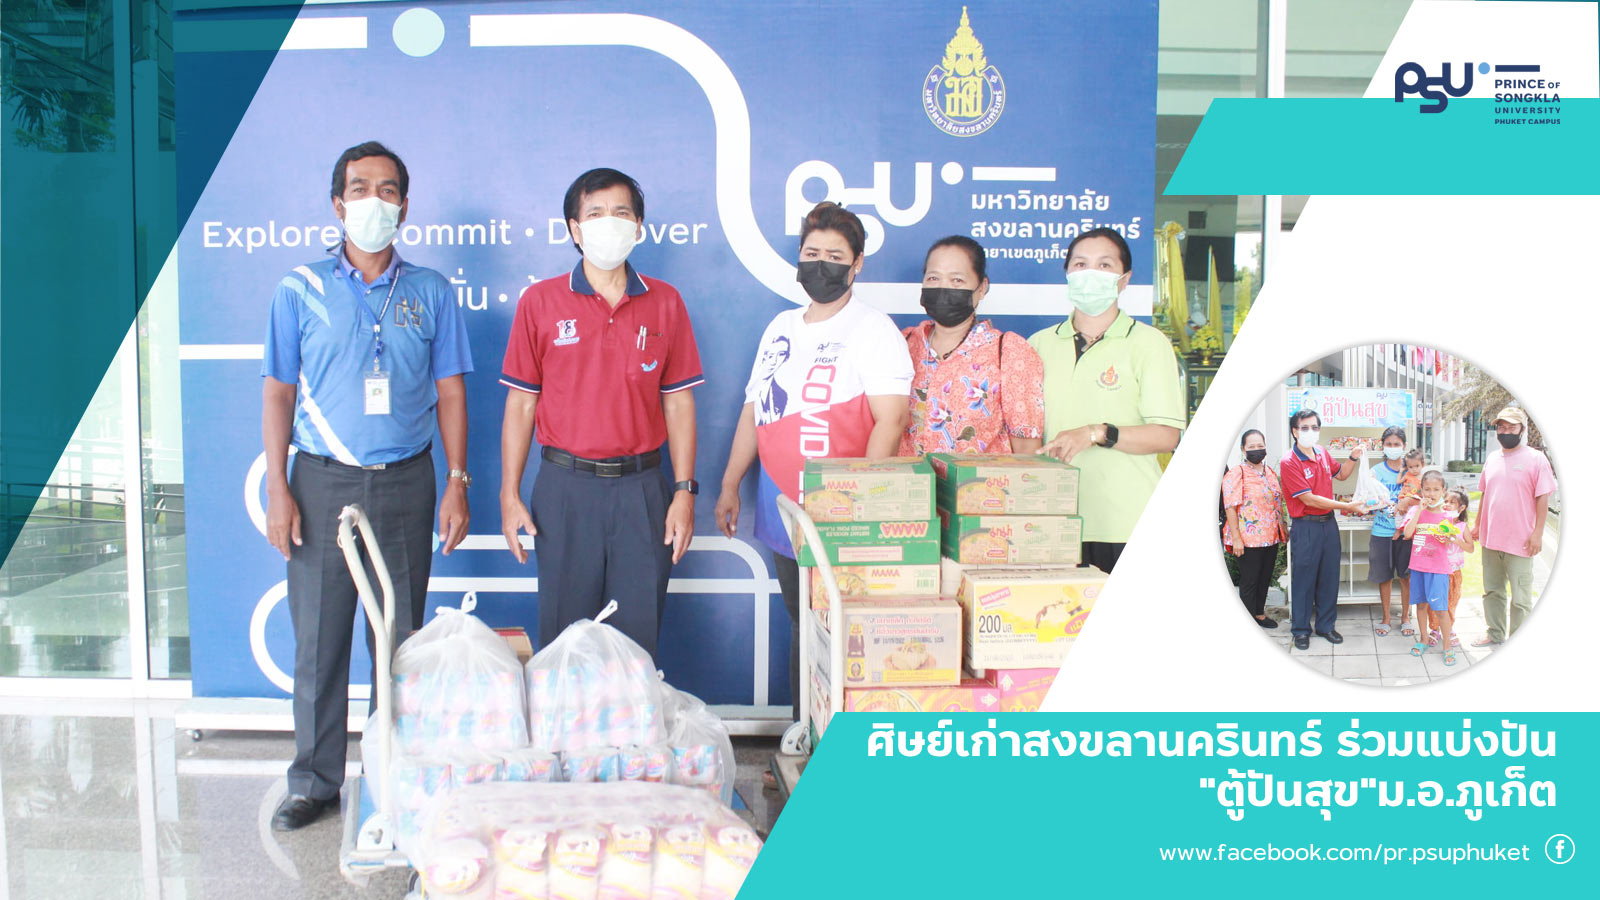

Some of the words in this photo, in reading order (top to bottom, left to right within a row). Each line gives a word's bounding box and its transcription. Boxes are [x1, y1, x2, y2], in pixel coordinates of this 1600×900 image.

[971, 188, 1110, 211] มหาวิทยาลัย
[202, 220, 340, 254] Explore
[392, 218, 512, 247] ommit
[814, 356, 839, 364] FIGHT
[1322, 396, 1388, 425] ตู้ปันสุข
[826, 481, 858, 490] MAMA
[880, 522, 928, 538] MAMA
[871, 569, 900, 578] MAMA
[978, 614, 1001, 634] 200
